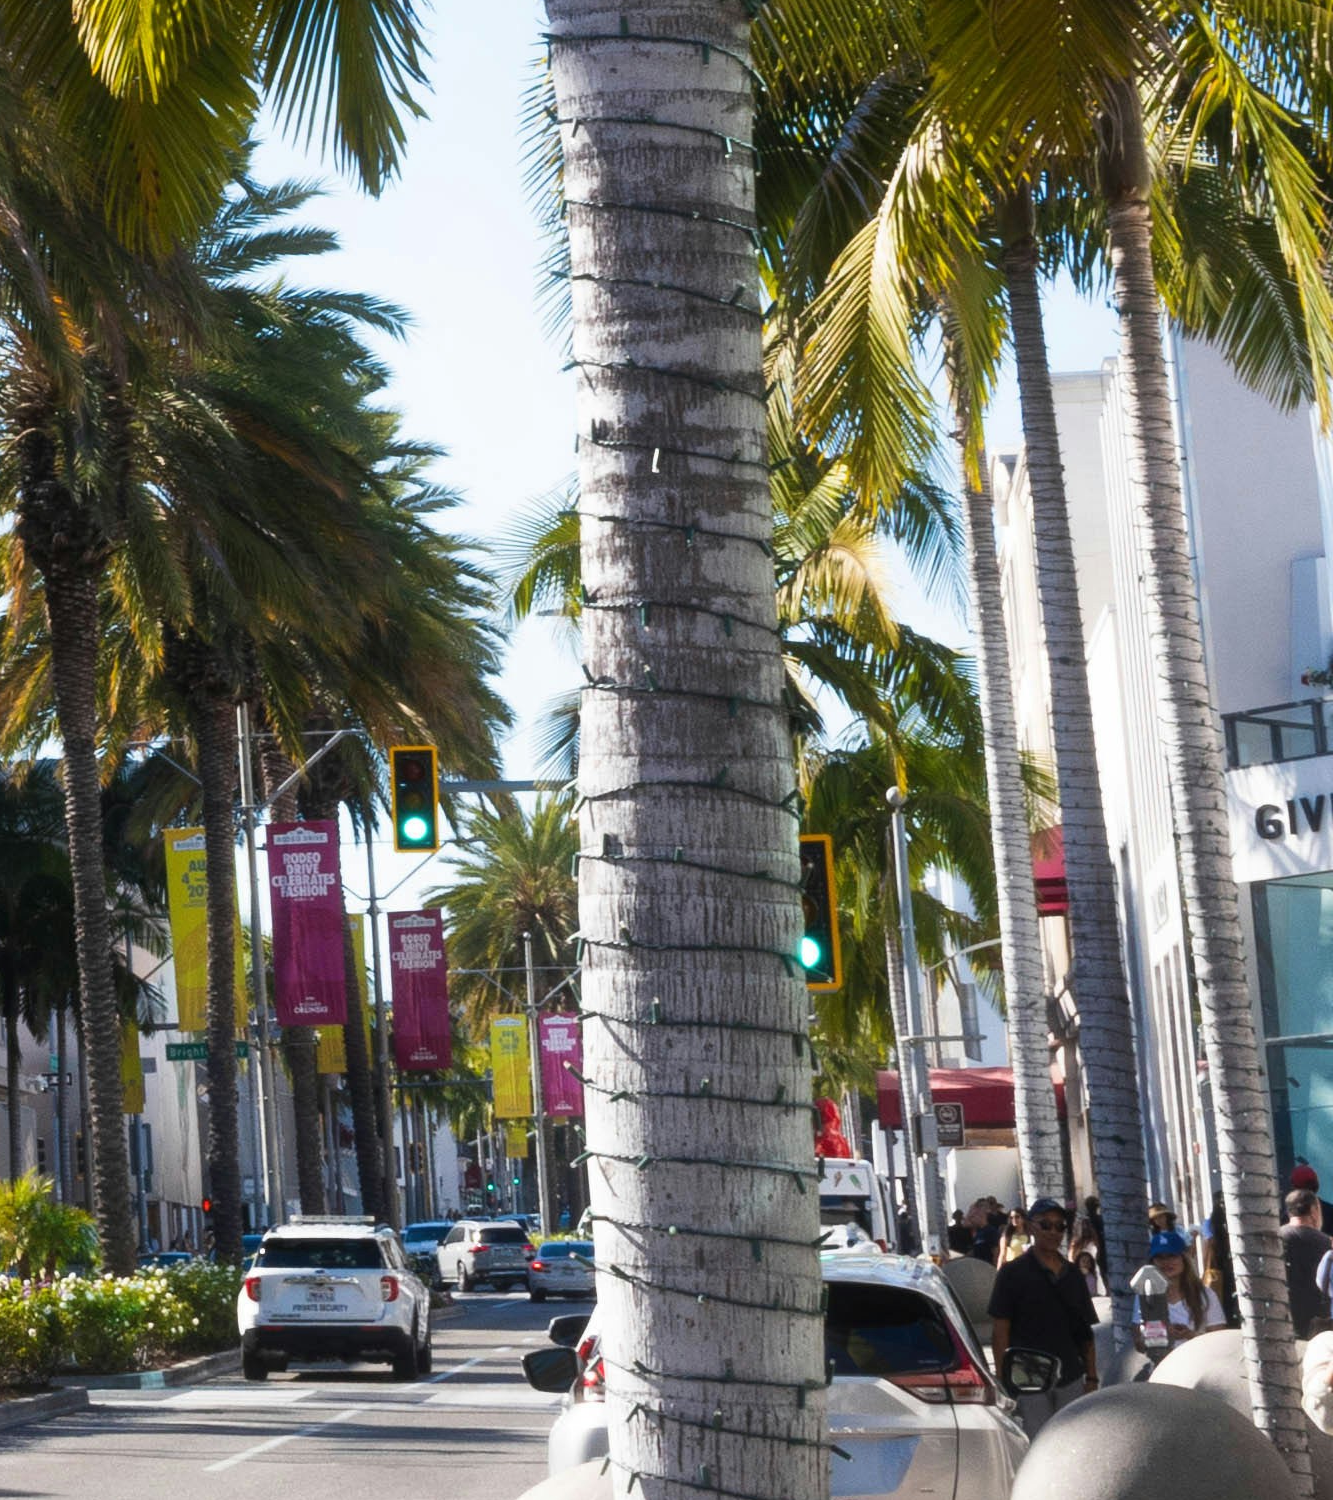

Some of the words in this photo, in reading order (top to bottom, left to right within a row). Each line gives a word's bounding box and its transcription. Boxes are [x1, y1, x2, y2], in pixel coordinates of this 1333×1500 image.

[1254, 793, 1333, 840] GIV
[283, 852, 321, 865] RODEO
[189, 860, 206, 872] AU
[286, 863, 319, 875] DRIVE
[272, 873, 336, 887] CELEBRATES
[188, 884, 207, 897] 20
[281, 885, 328, 898] FASHION
[170, 1047, 208, 1058] Bright
